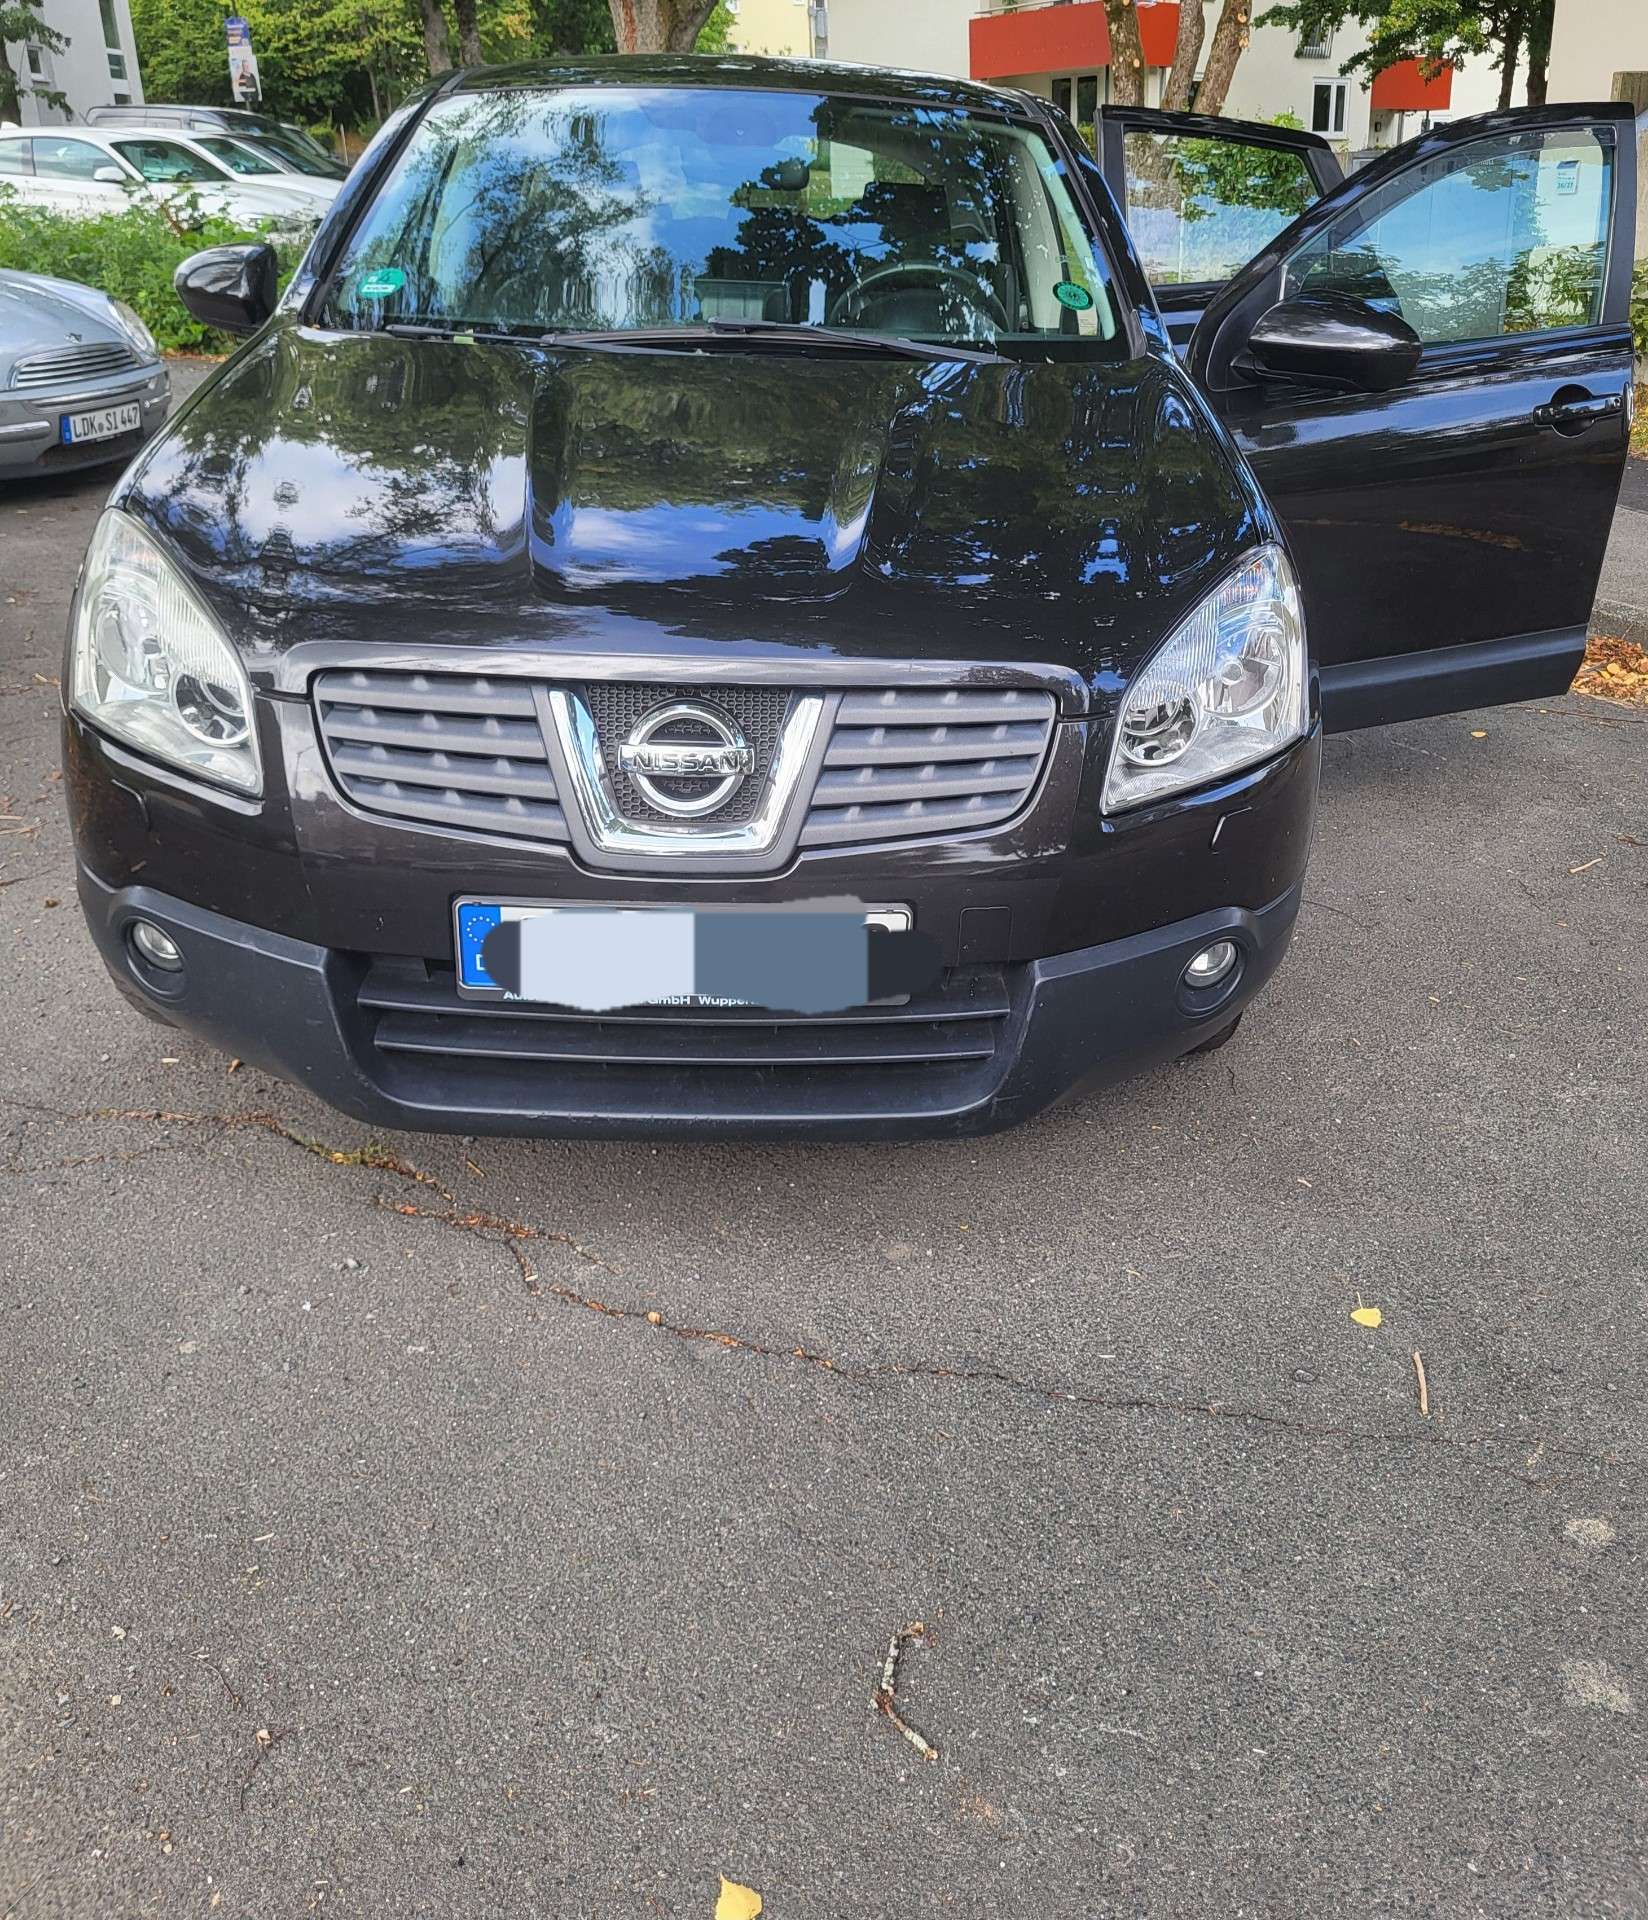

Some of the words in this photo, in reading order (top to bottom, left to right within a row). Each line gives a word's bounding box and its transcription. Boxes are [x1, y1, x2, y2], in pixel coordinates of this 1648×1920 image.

[73, 415, 97, 438] LDK
[105, 411, 119, 431] SI
[121, 407, 138, 426] 447
[632, 751, 740, 771] NISSAN
